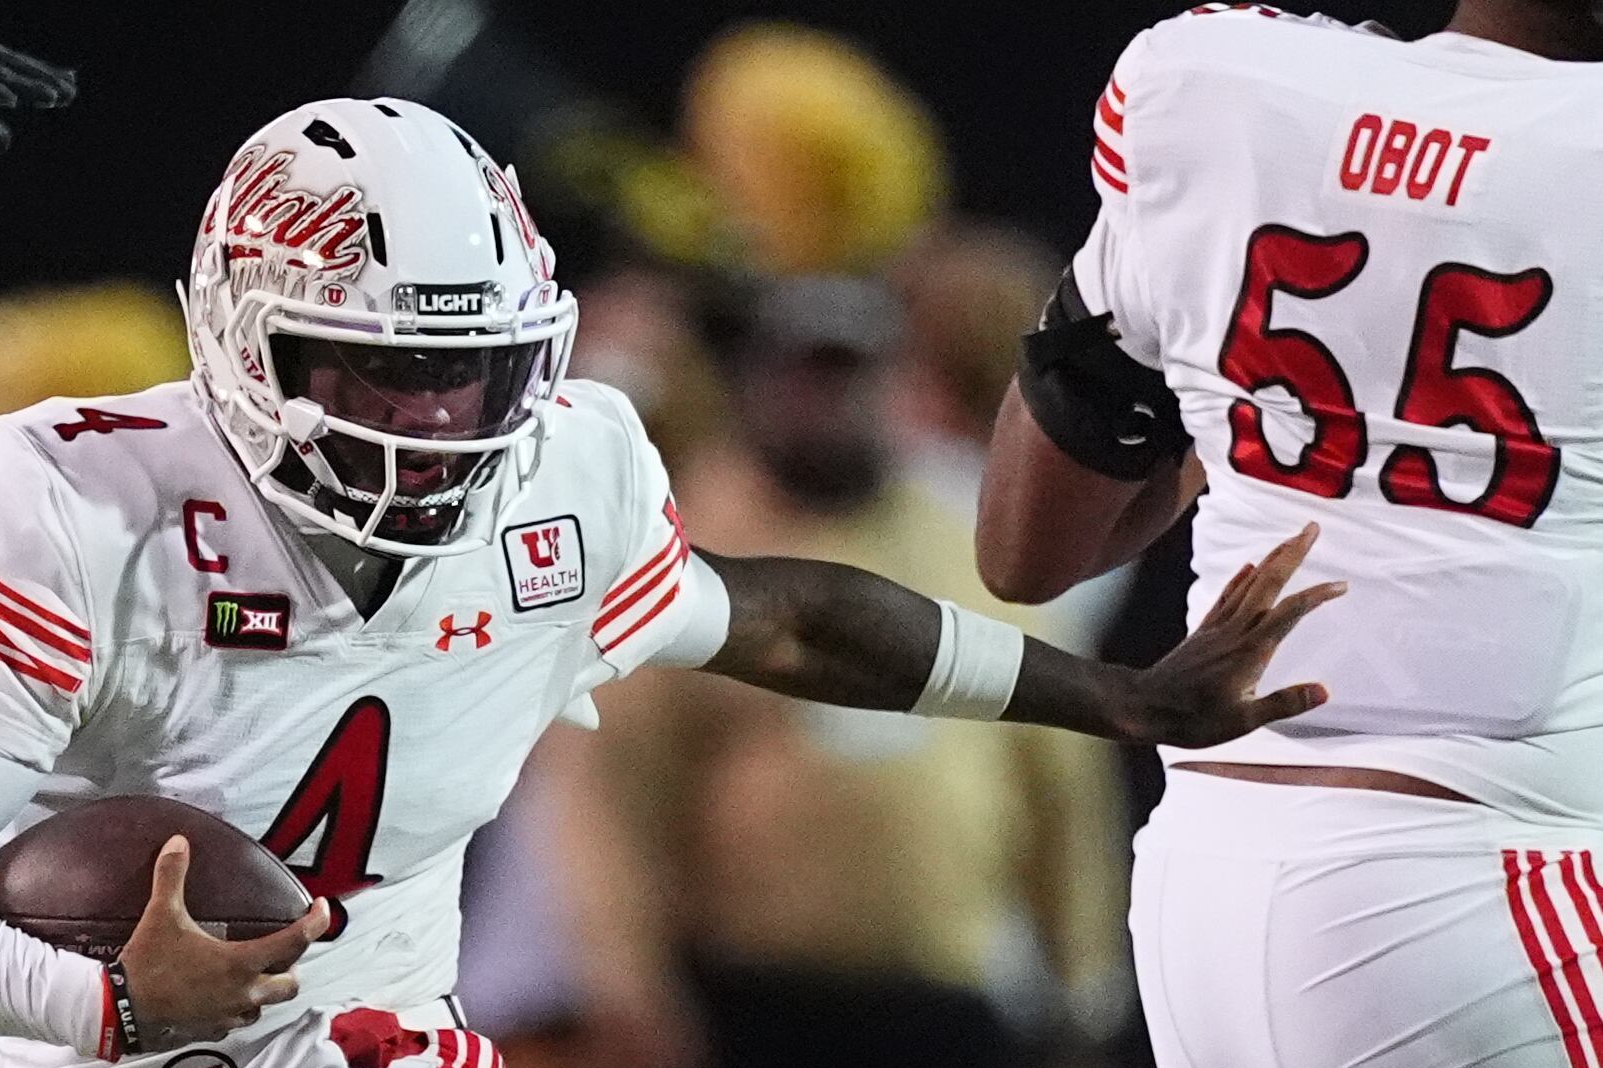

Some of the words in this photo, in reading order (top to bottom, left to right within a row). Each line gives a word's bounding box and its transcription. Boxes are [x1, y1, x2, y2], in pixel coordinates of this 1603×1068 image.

[1340, 113, 1491, 206] OBOT
[419, 294, 481, 312] LIGHT
[1219, 223, 1561, 529] 55
[52, 407, 168, 441] 4
[183, 499, 229, 573] C
[518, 568, 579, 593] HEALTH
[258, 695, 391, 942] 4
